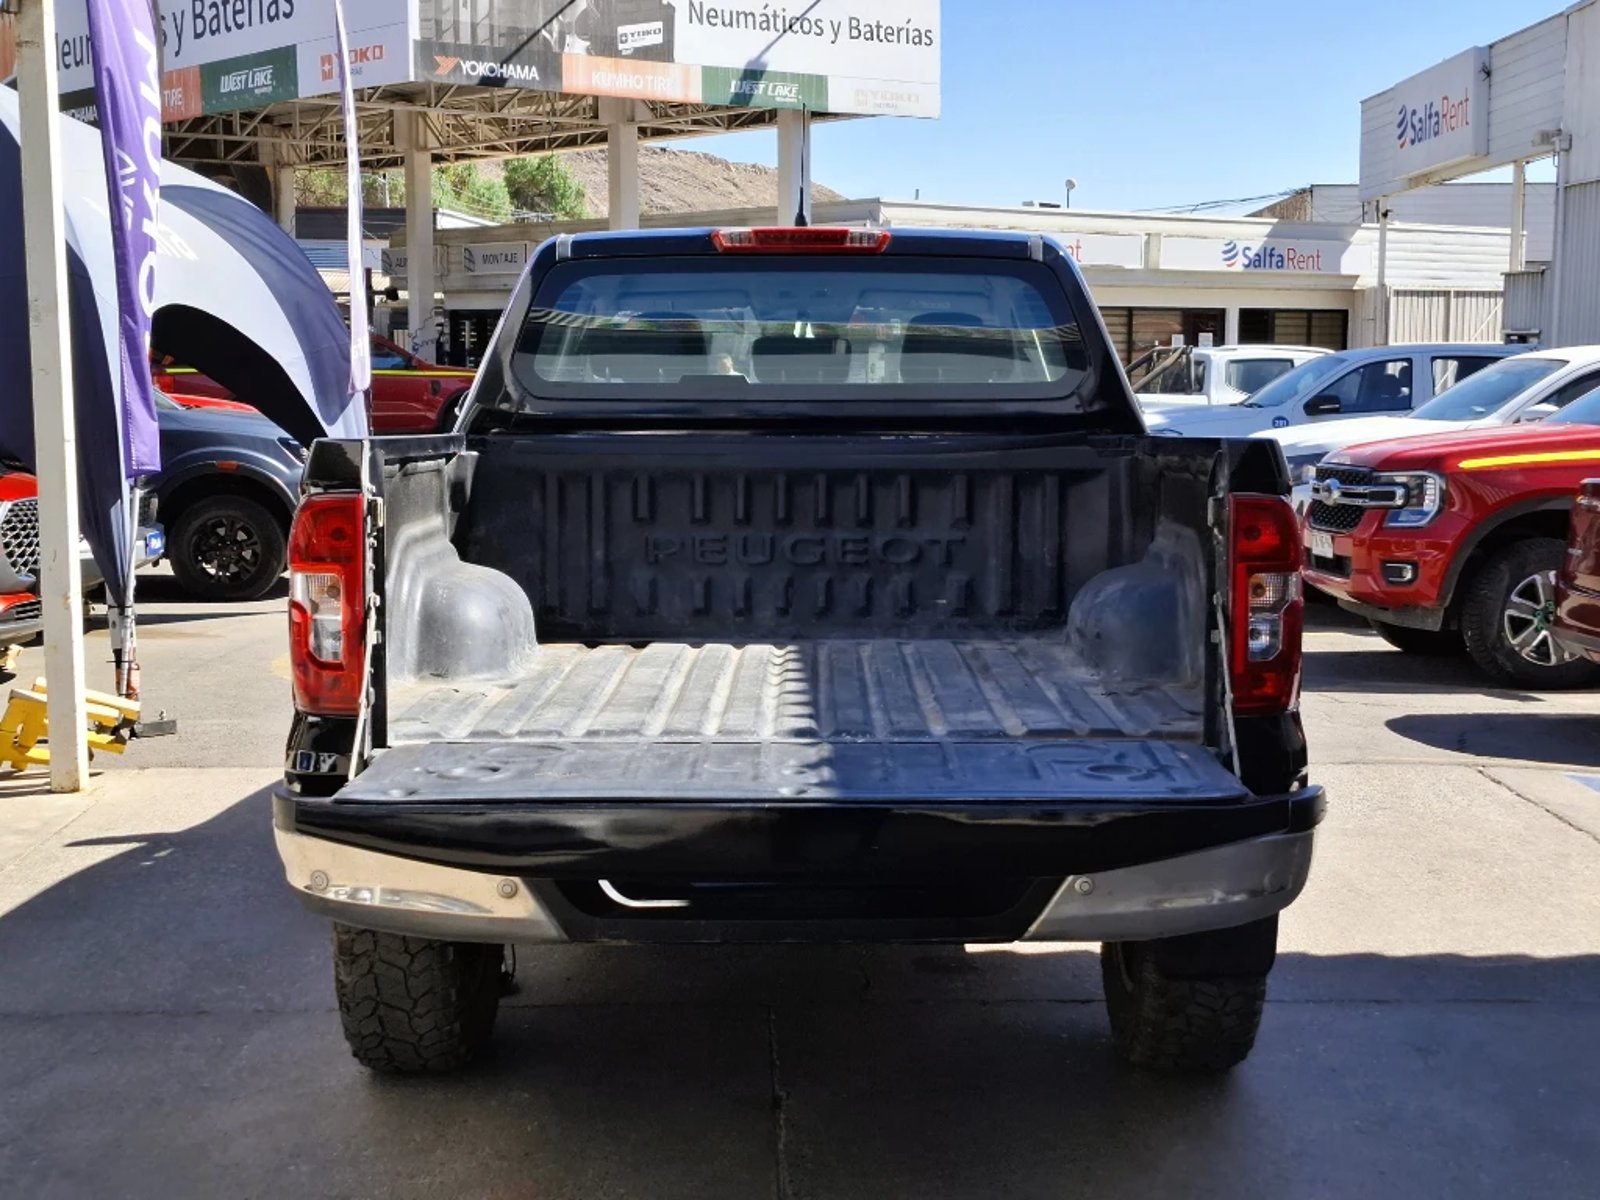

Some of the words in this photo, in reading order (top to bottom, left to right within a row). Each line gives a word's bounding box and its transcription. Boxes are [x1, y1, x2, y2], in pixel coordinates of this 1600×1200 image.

[172, 9, 185, 57] y
[688, 0, 824, 37] Neumáticos
[830, 19, 842, 45] y
[849, 16, 934, 47] Baterías
[220, 69, 248, 93] WEST
[248, 65, 273, 88] LAKE
[459, 60, 540, 81] YOKOHAMA
[591, 71, 643, 90] KUMHO
[730, 79, 767, 95] WEST
[767, 81, 800, 98] LAKE
[1410, 87, 1470, 146] SalfaRent
[482, 252, 518, 265] MONTAJE
[1241, 246, 1322, 272] SalfaRent
[645, 533, 967, 568] PEUGEOT
